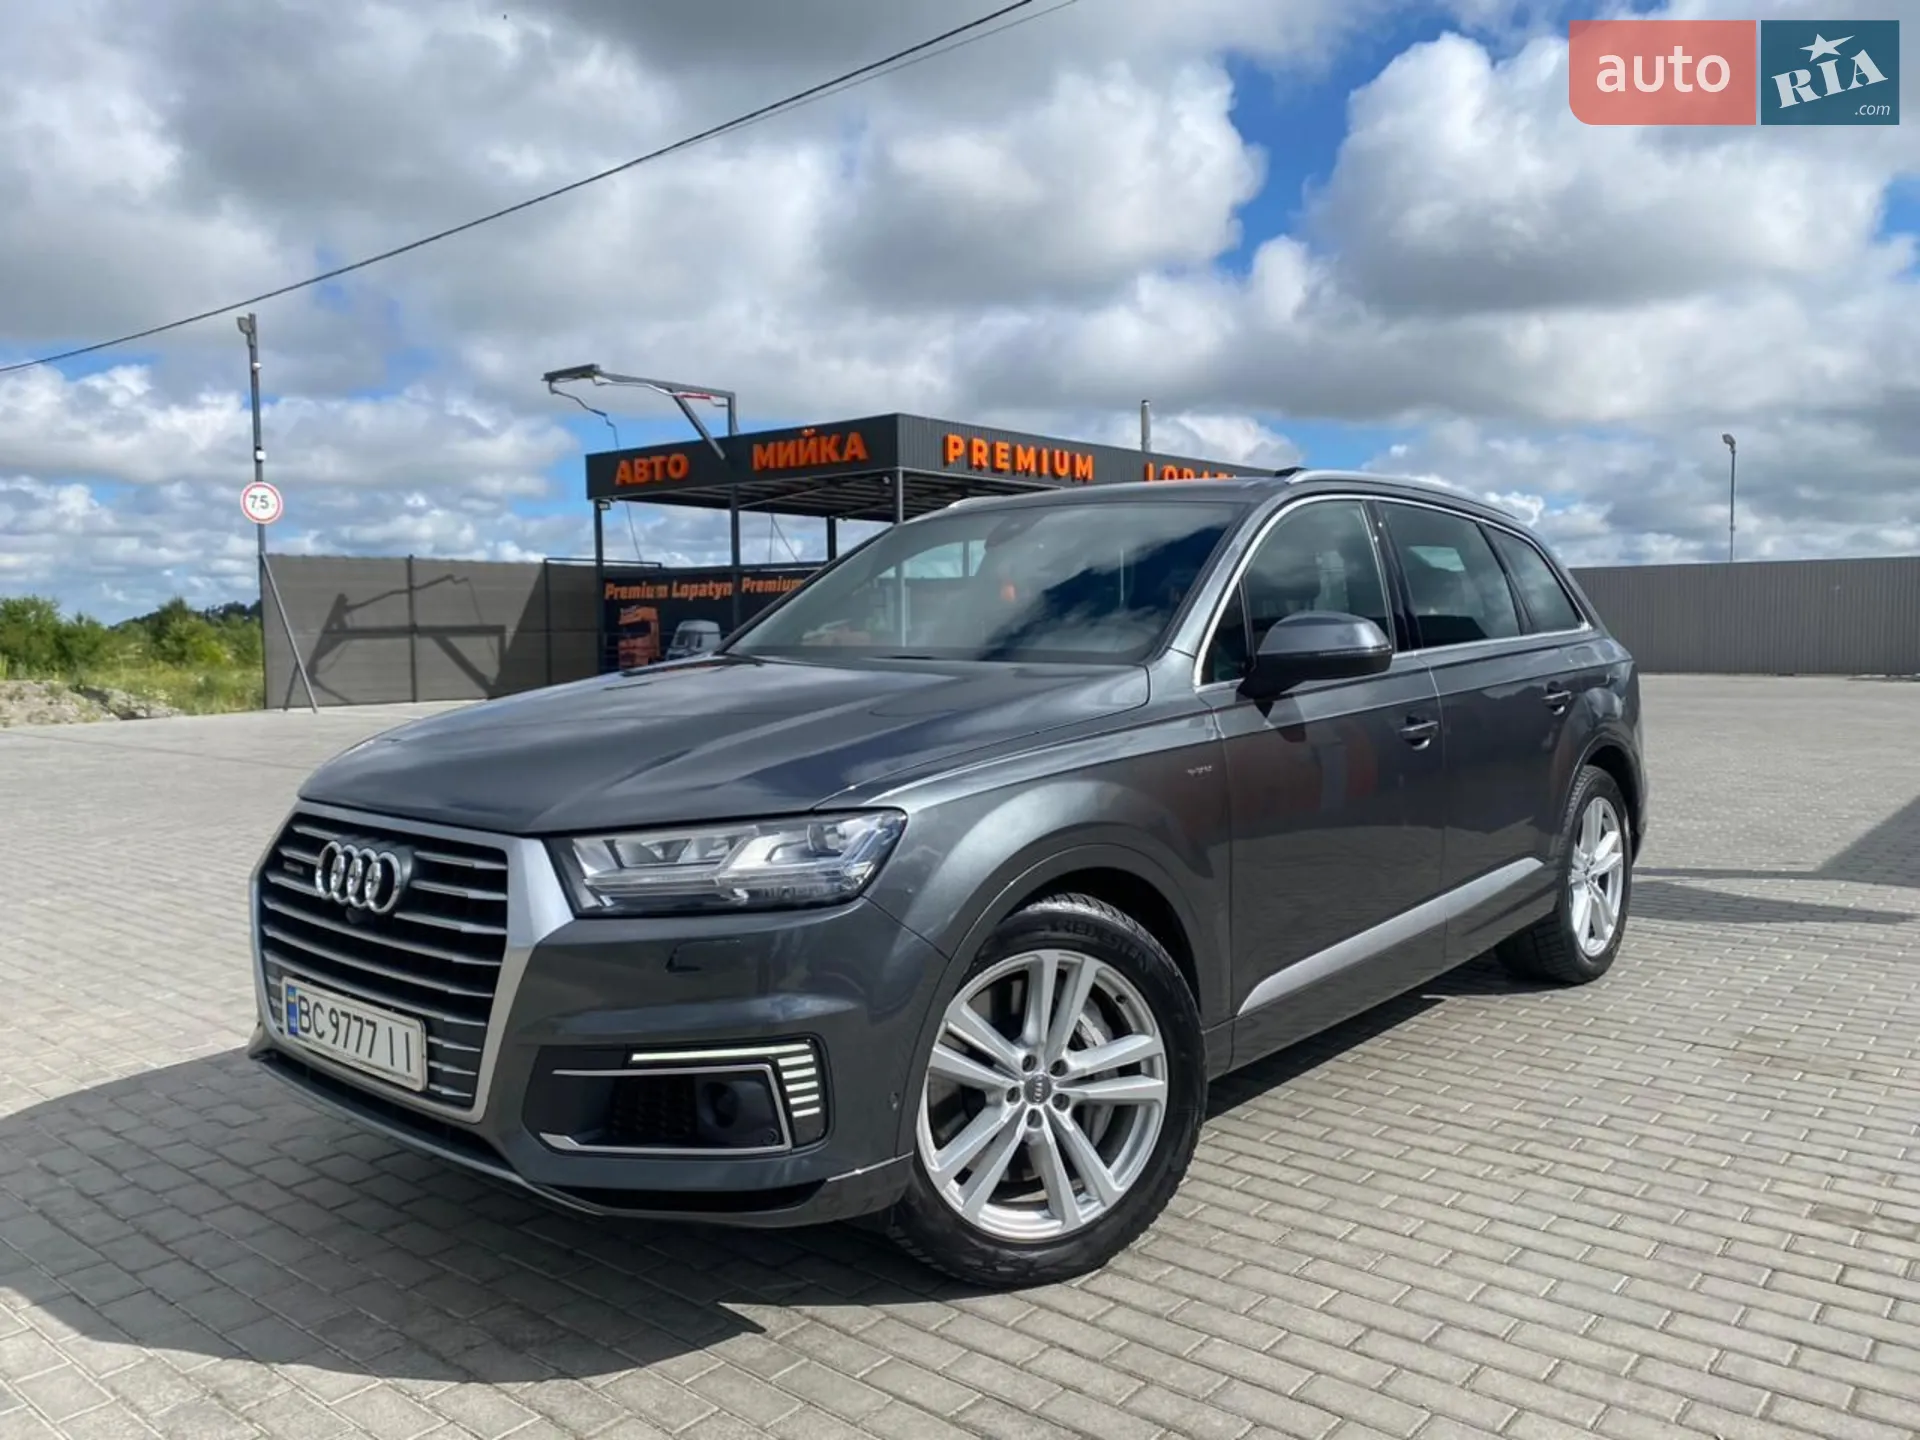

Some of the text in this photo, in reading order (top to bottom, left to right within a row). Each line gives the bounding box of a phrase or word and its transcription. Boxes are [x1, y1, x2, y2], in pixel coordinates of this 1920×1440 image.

[615, 428, 869, 487] АВТО МИЙКА
[944, 433, 1095, 481] PREMIUM
[604, 579, 733, 601] Premium Lopatyn
